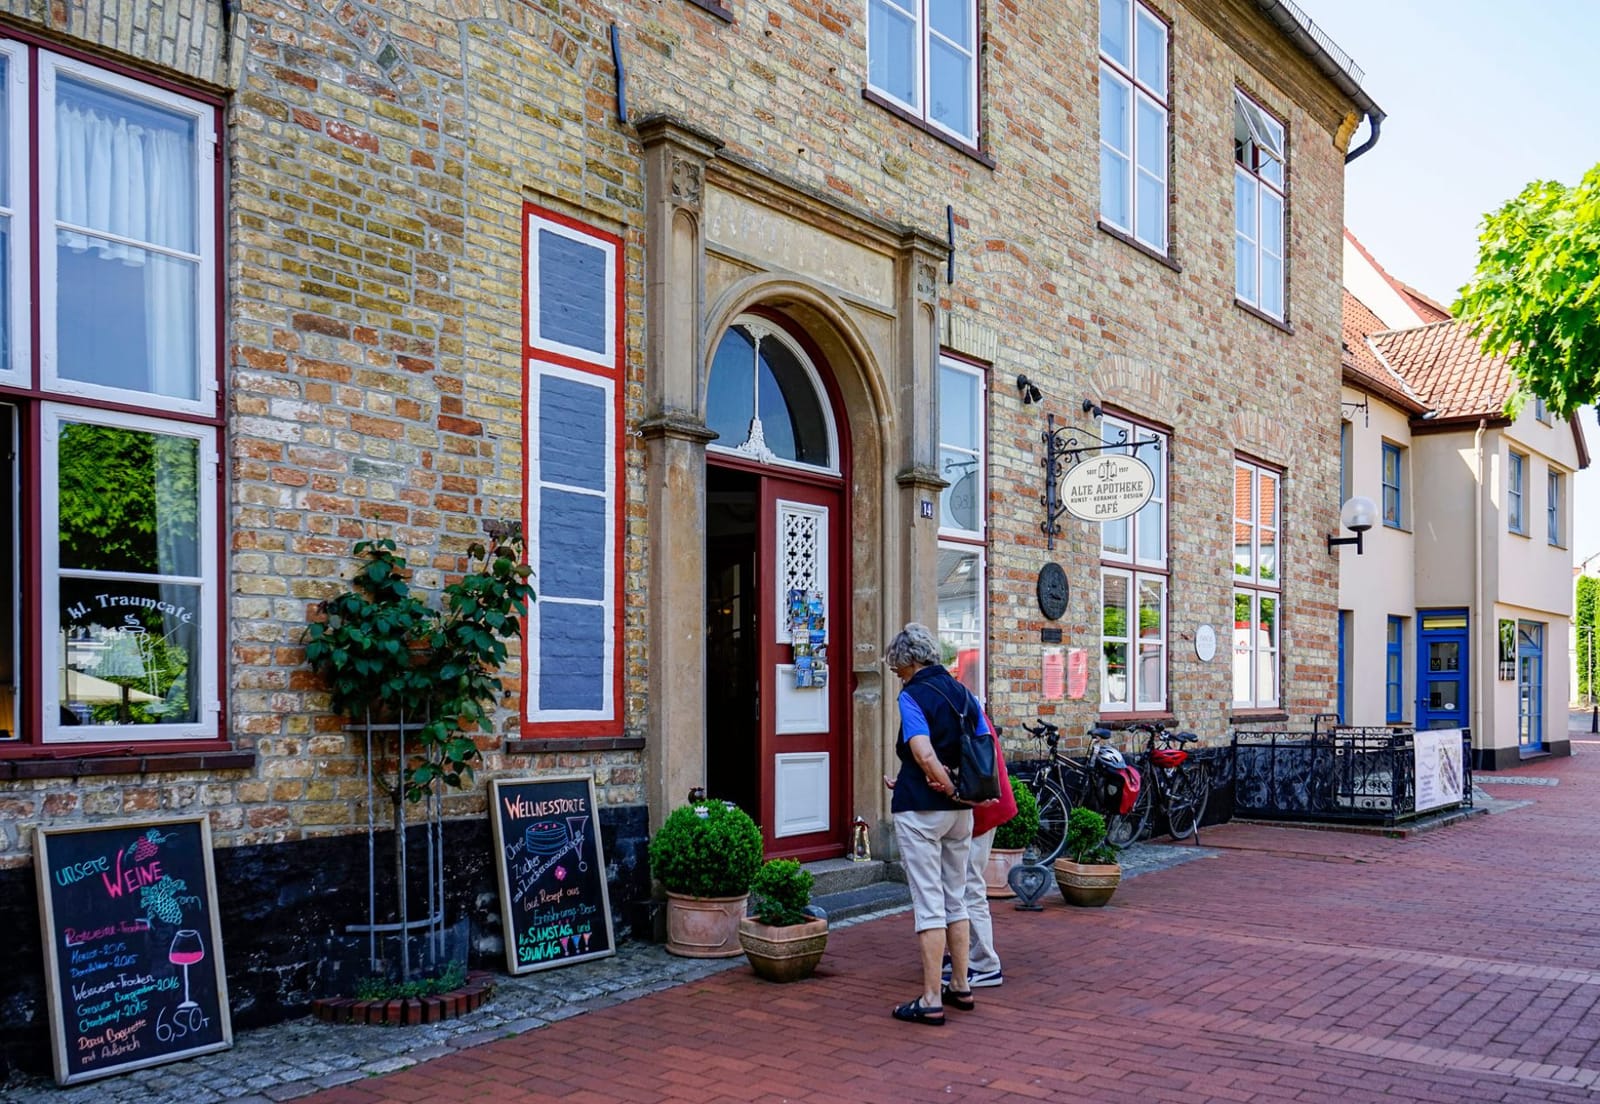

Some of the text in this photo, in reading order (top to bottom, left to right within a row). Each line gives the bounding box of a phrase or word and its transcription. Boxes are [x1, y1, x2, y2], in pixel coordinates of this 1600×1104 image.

[1071, 481, 1144, 497] ALTE APOTHEKE
[1071, 496, 1088, 504] KUNST
[923, 503, 932, 516] 14
[1095, 501, 1119, 515] CAFÉ
[67, 593, 193, 624] kl. Traumcafé
[504, 794, 586, 820] WELLNESSTORTE
[101, 849, 163, 898] WEINE
[527, 923, 574, 945] SAMSTAG
[518, 940, 561, 963] SONNTAG
